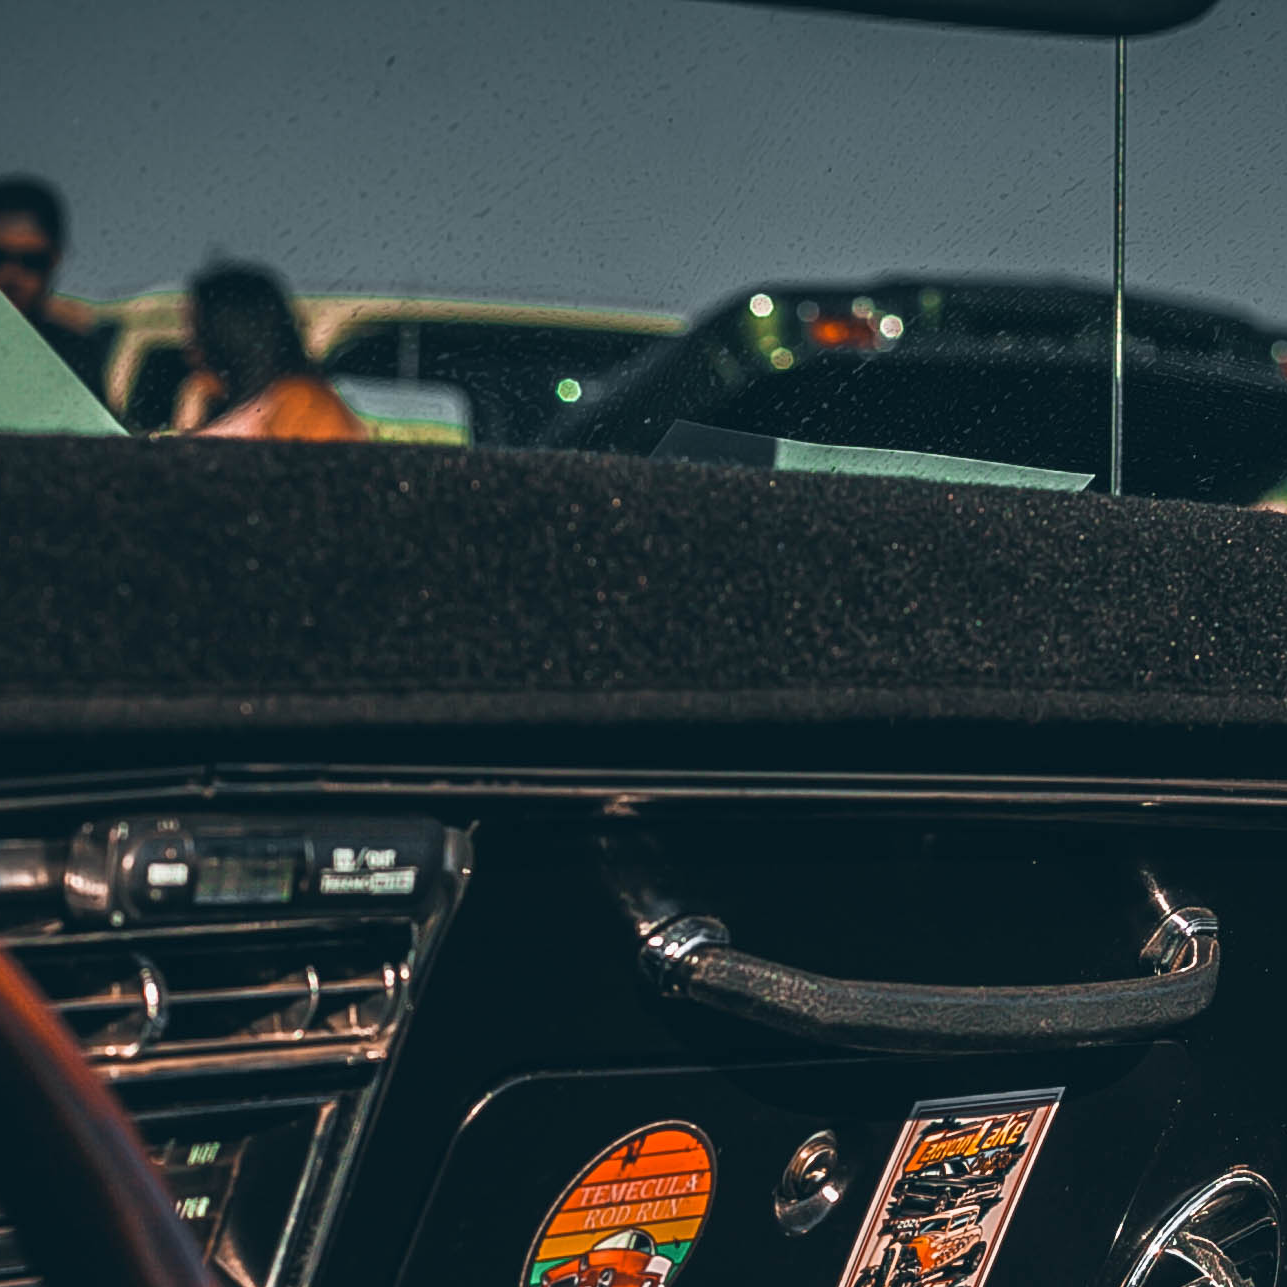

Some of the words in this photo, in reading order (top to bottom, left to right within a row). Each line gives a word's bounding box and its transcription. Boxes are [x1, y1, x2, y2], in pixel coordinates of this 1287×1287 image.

[964, 1113, 1028, 1156] Lake
[580, 1173, 699, 1206] TEMECULA
[584, 1205, 631, 1229] ROD
[635, 1198, 683, 1222] RUN
